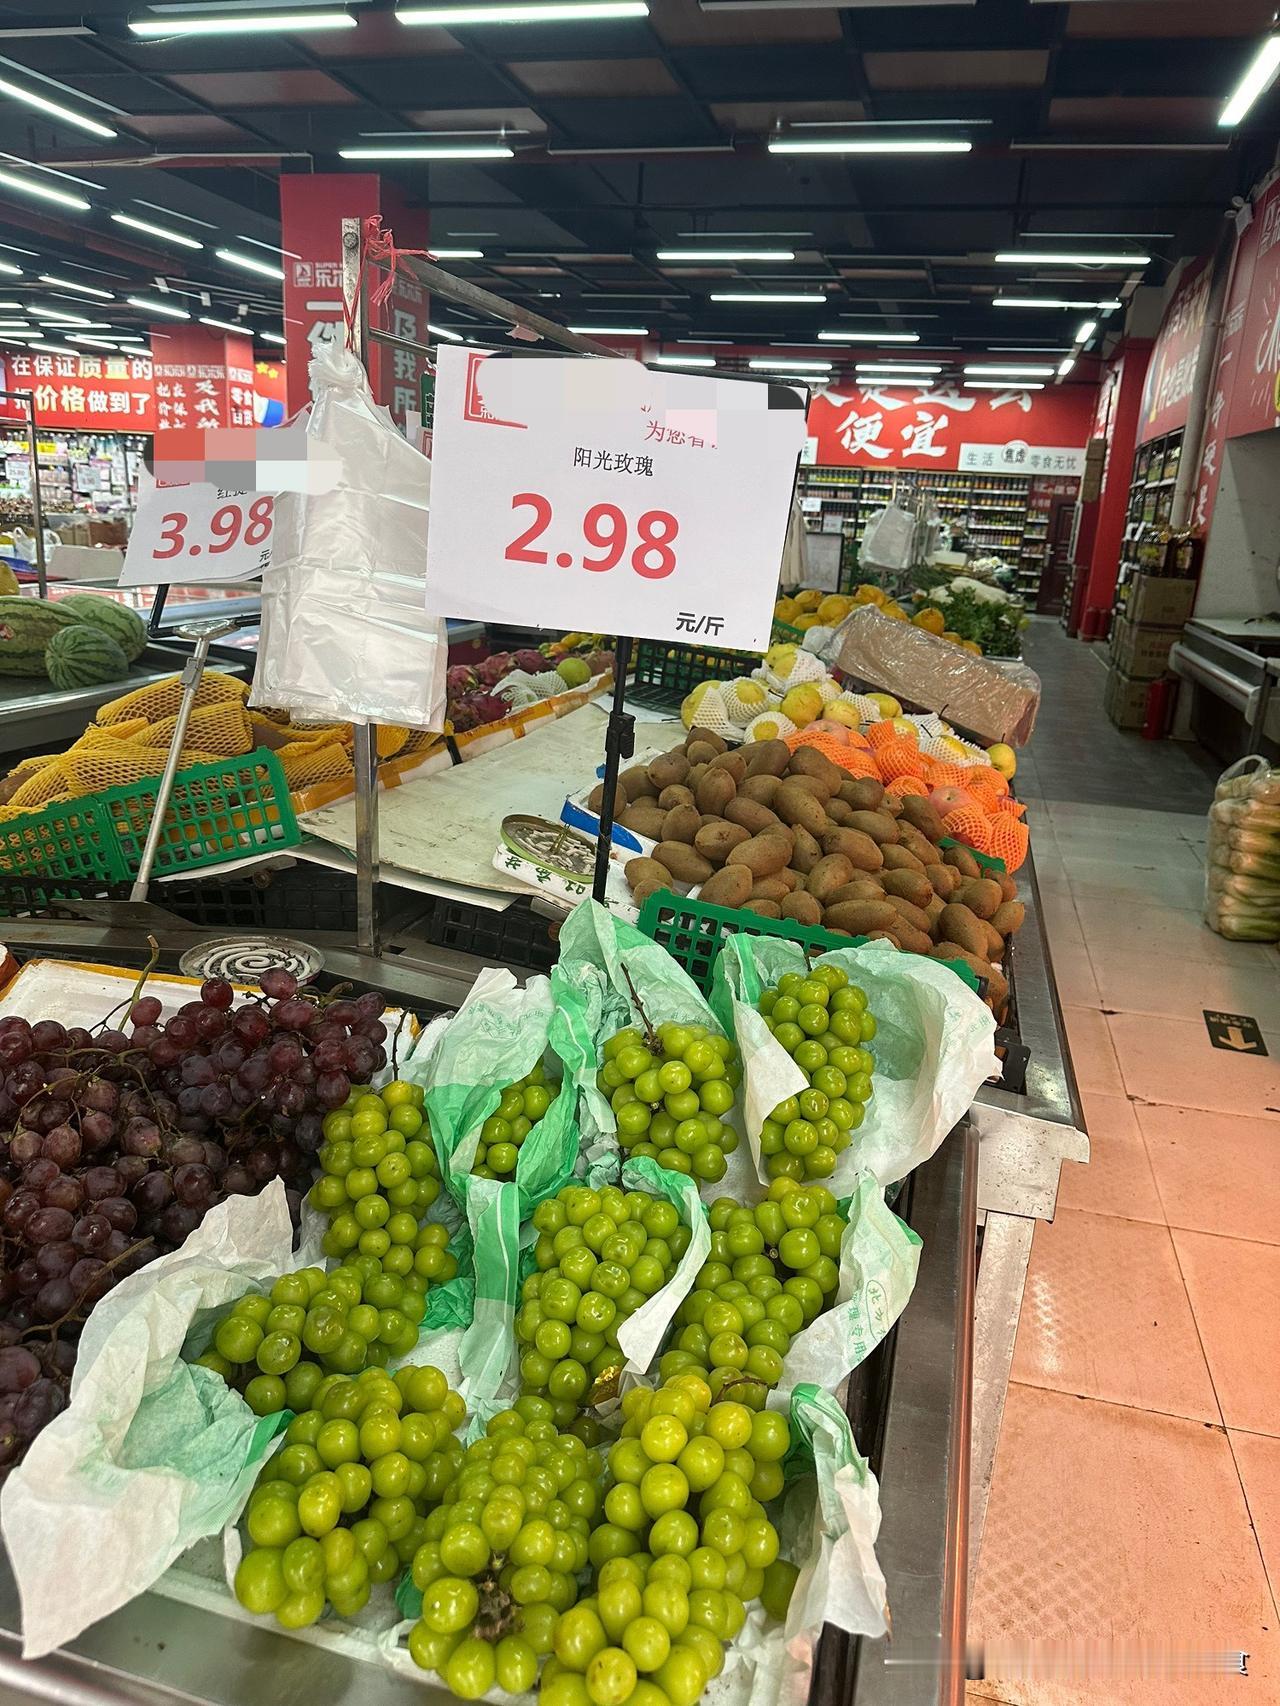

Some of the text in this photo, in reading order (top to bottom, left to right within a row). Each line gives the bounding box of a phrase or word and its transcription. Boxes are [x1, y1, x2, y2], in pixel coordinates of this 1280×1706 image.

[11, 355, 152, 380] 在保证质量的
[835, 410, 950, 459] 便宜
[573, 446, 654, 477] 阳光玫瑰
[966, 452, 994, 467] 生活
[1030, 454, 1077, 470] 零食无忧
[152, 495, 273, 560] 3.98
[505, 492, 680, 580] 2.98
[675, 611, 725, 636] 元/斤
